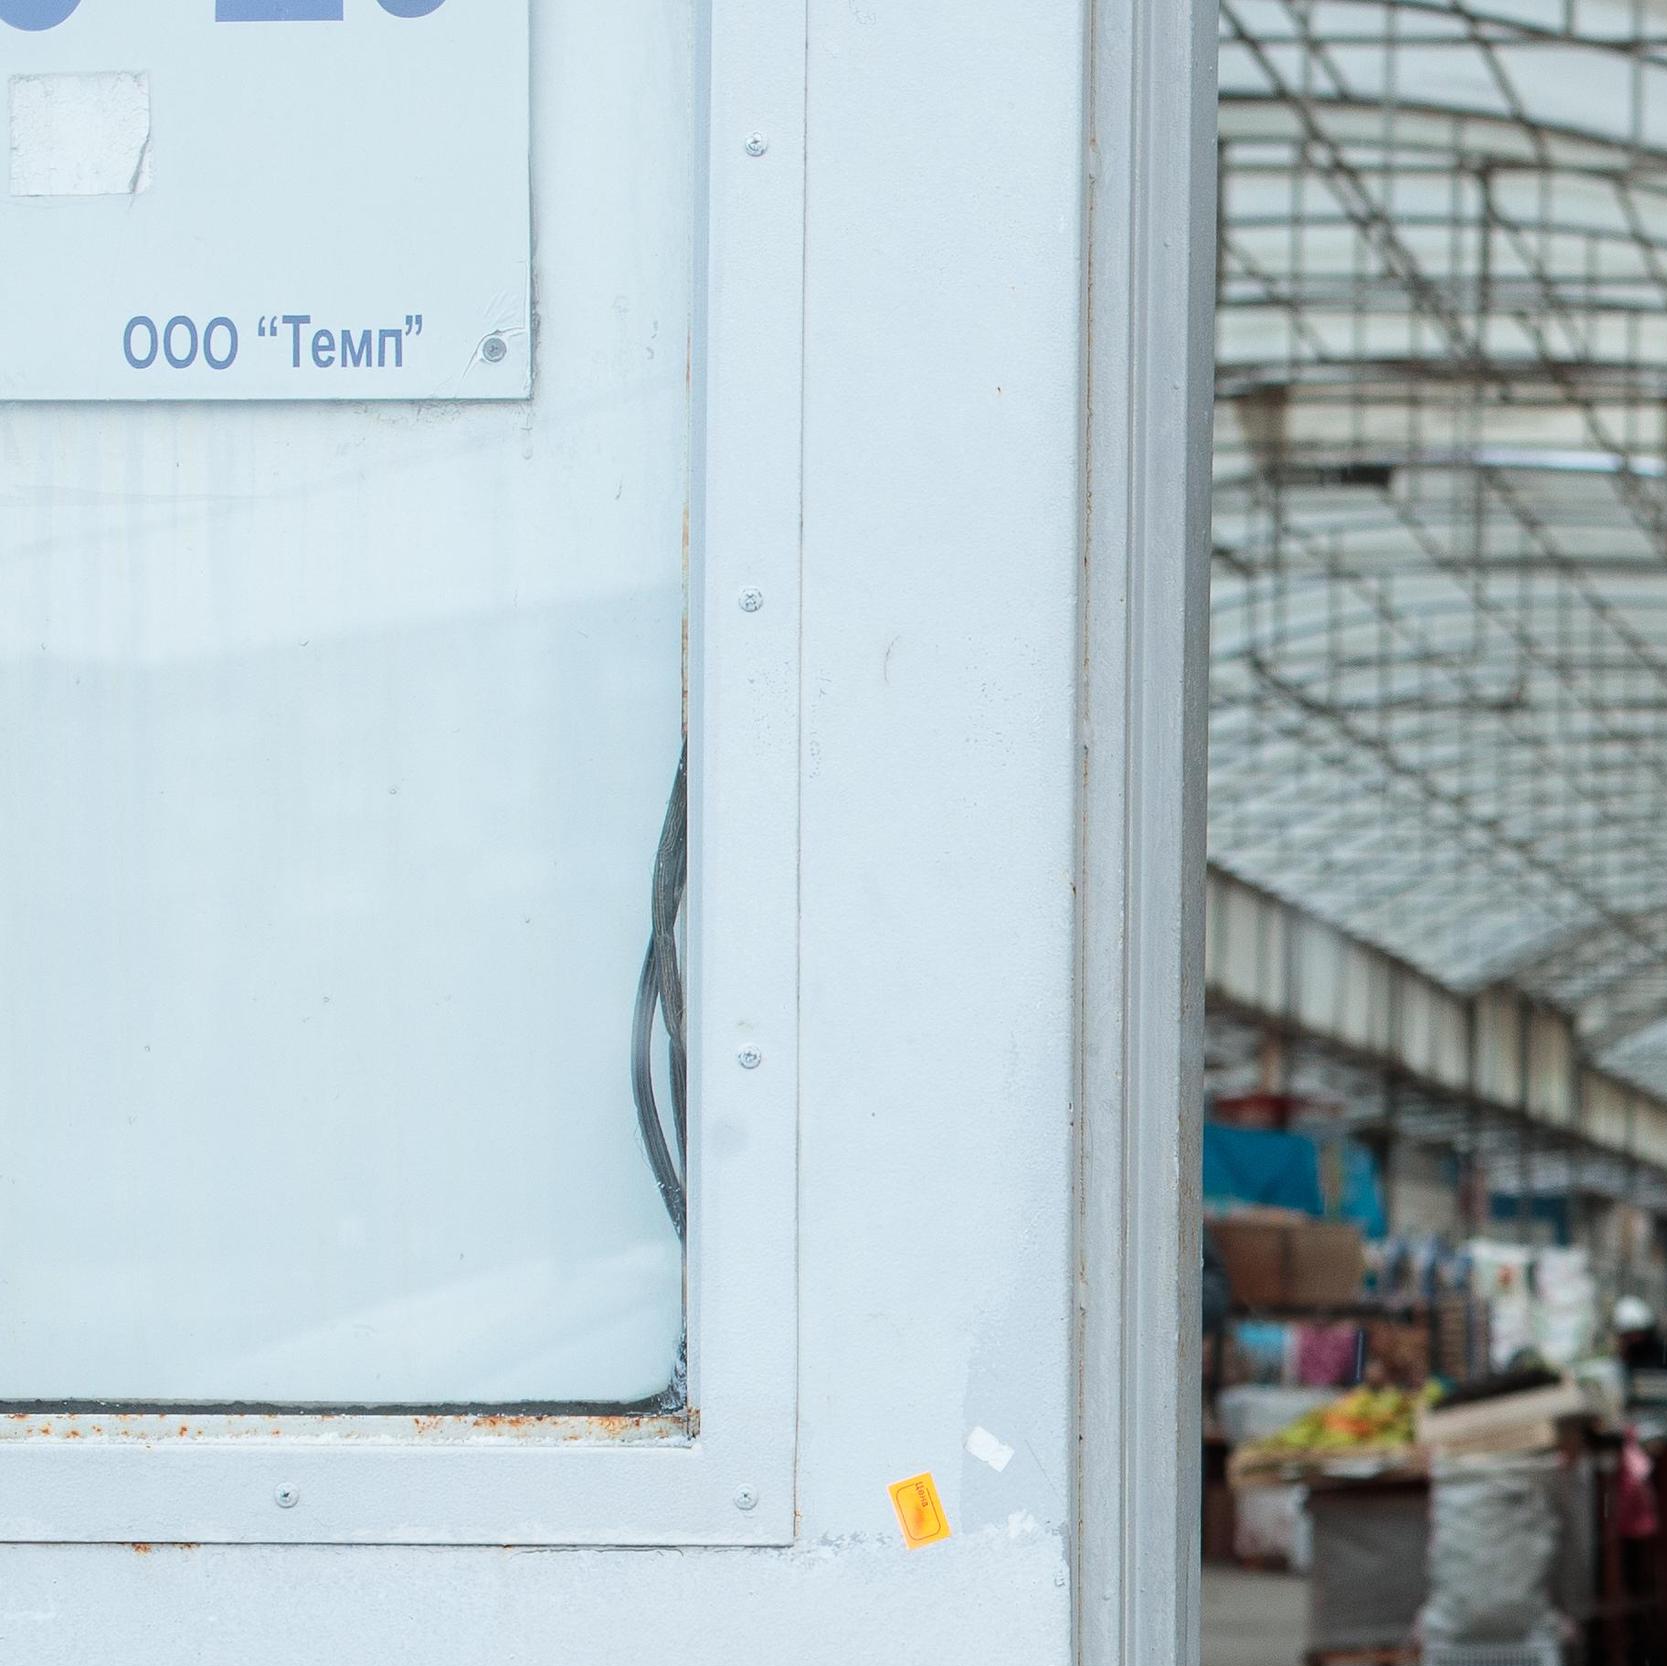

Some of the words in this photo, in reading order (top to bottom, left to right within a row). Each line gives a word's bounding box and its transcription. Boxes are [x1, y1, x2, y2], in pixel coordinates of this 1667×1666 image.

[122, 314, 240, 370] ООО
[256, 313, 424, 369] “Темп”
[914, 1481, 929, 1508] Цена
